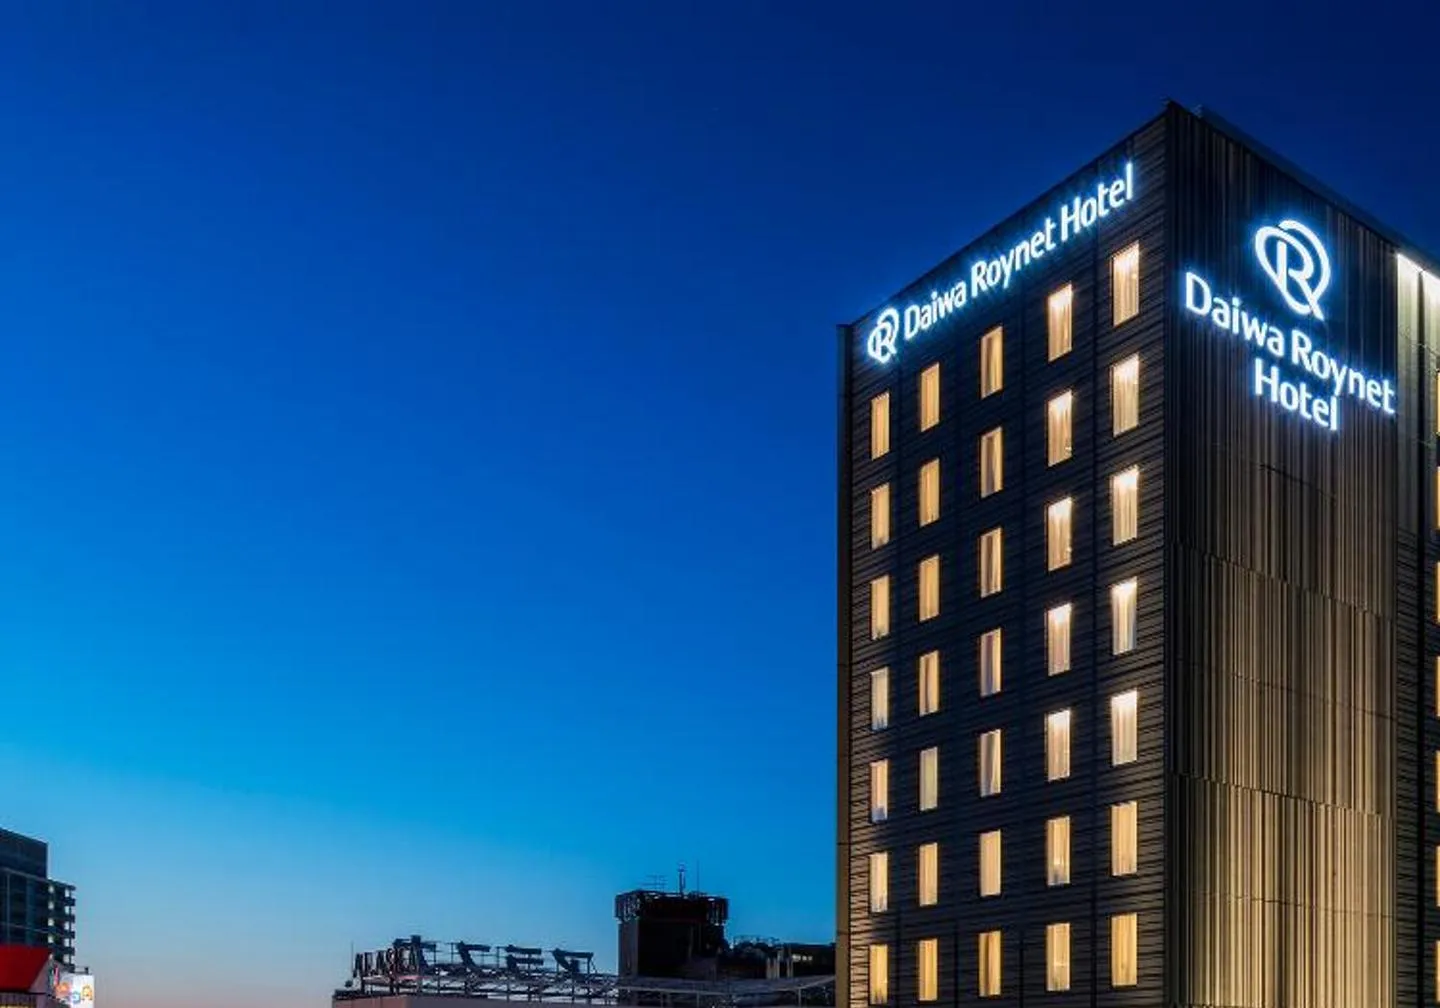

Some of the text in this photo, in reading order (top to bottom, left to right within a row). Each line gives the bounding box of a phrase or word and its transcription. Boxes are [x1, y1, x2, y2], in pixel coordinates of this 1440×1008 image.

[904, 280, 967, 340] Daiwa
[970, 216, 1057, 298] Roynet
[1060, 161, 1134, 241] Hotel
[1185, 271, 1395, 415] Daiwa Roynet
[1255, 357, 1338, 431] Hotel
